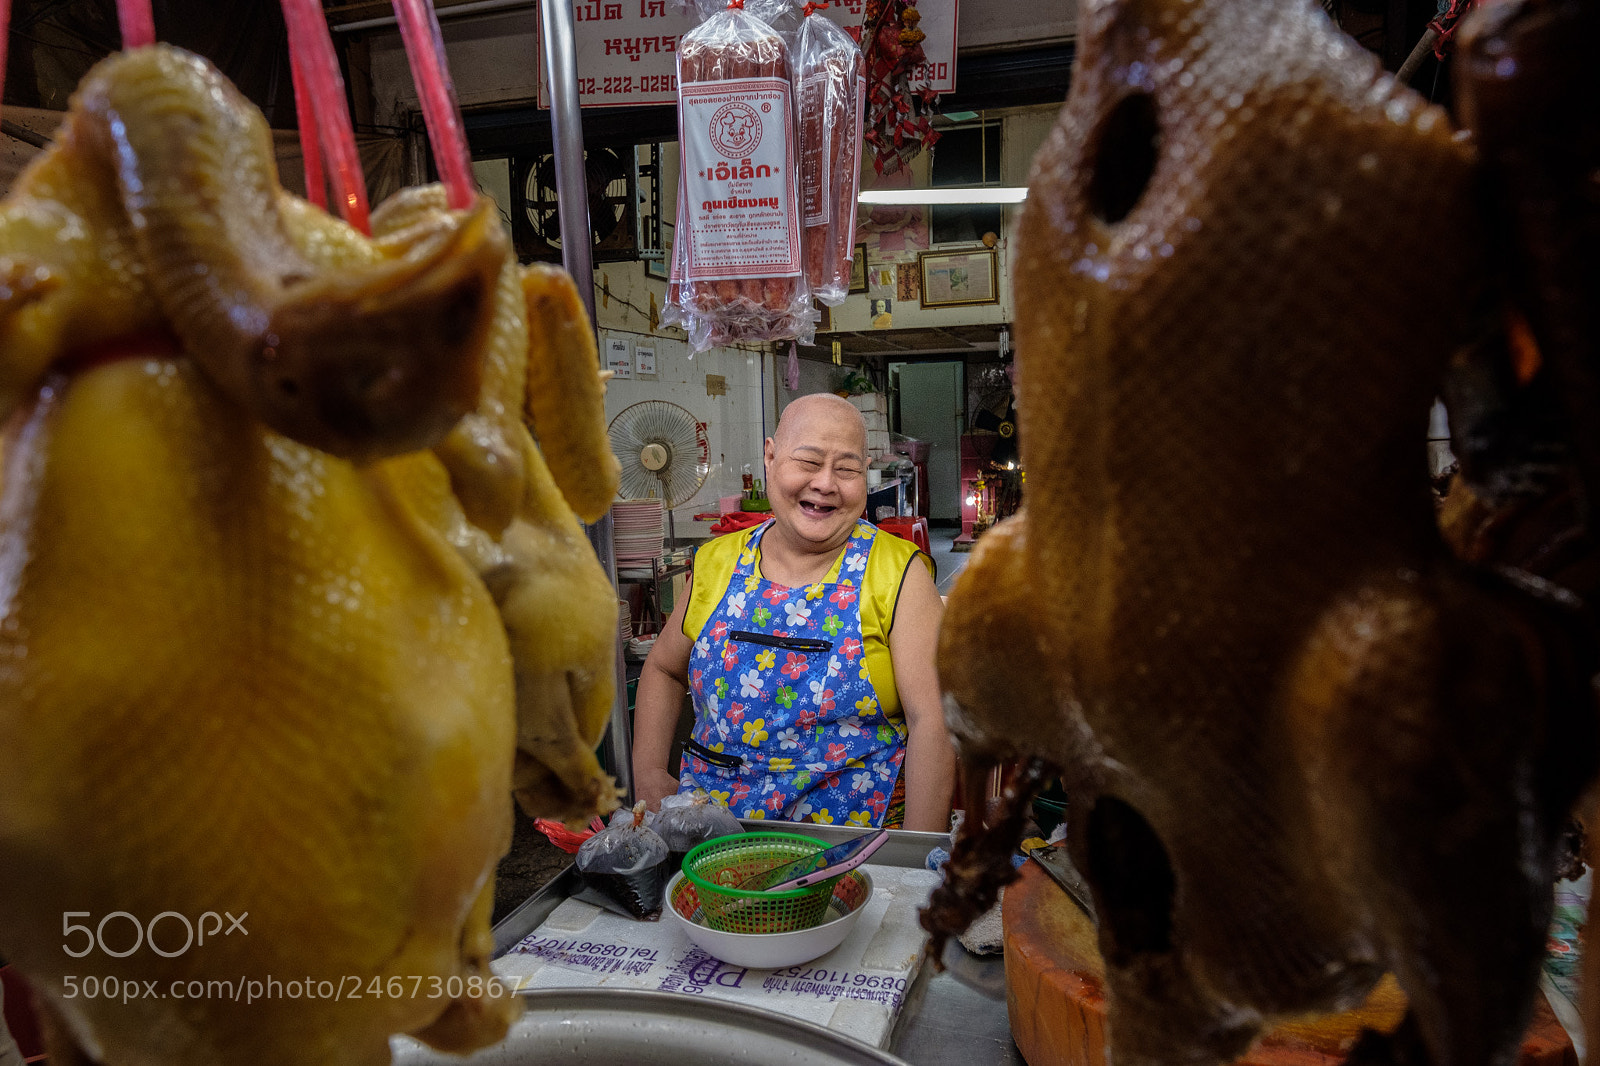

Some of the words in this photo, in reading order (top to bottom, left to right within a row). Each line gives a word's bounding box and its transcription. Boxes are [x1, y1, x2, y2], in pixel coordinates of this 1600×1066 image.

[604, 35, 682, 62] หมูกร
[689, 92, 781, 106] สุดยอดของฝากจากปากช่อง
[707, 158, 771, 181] เจ๊เล็ก
[702, 196, 779, 213] กุนเชียงหมู
